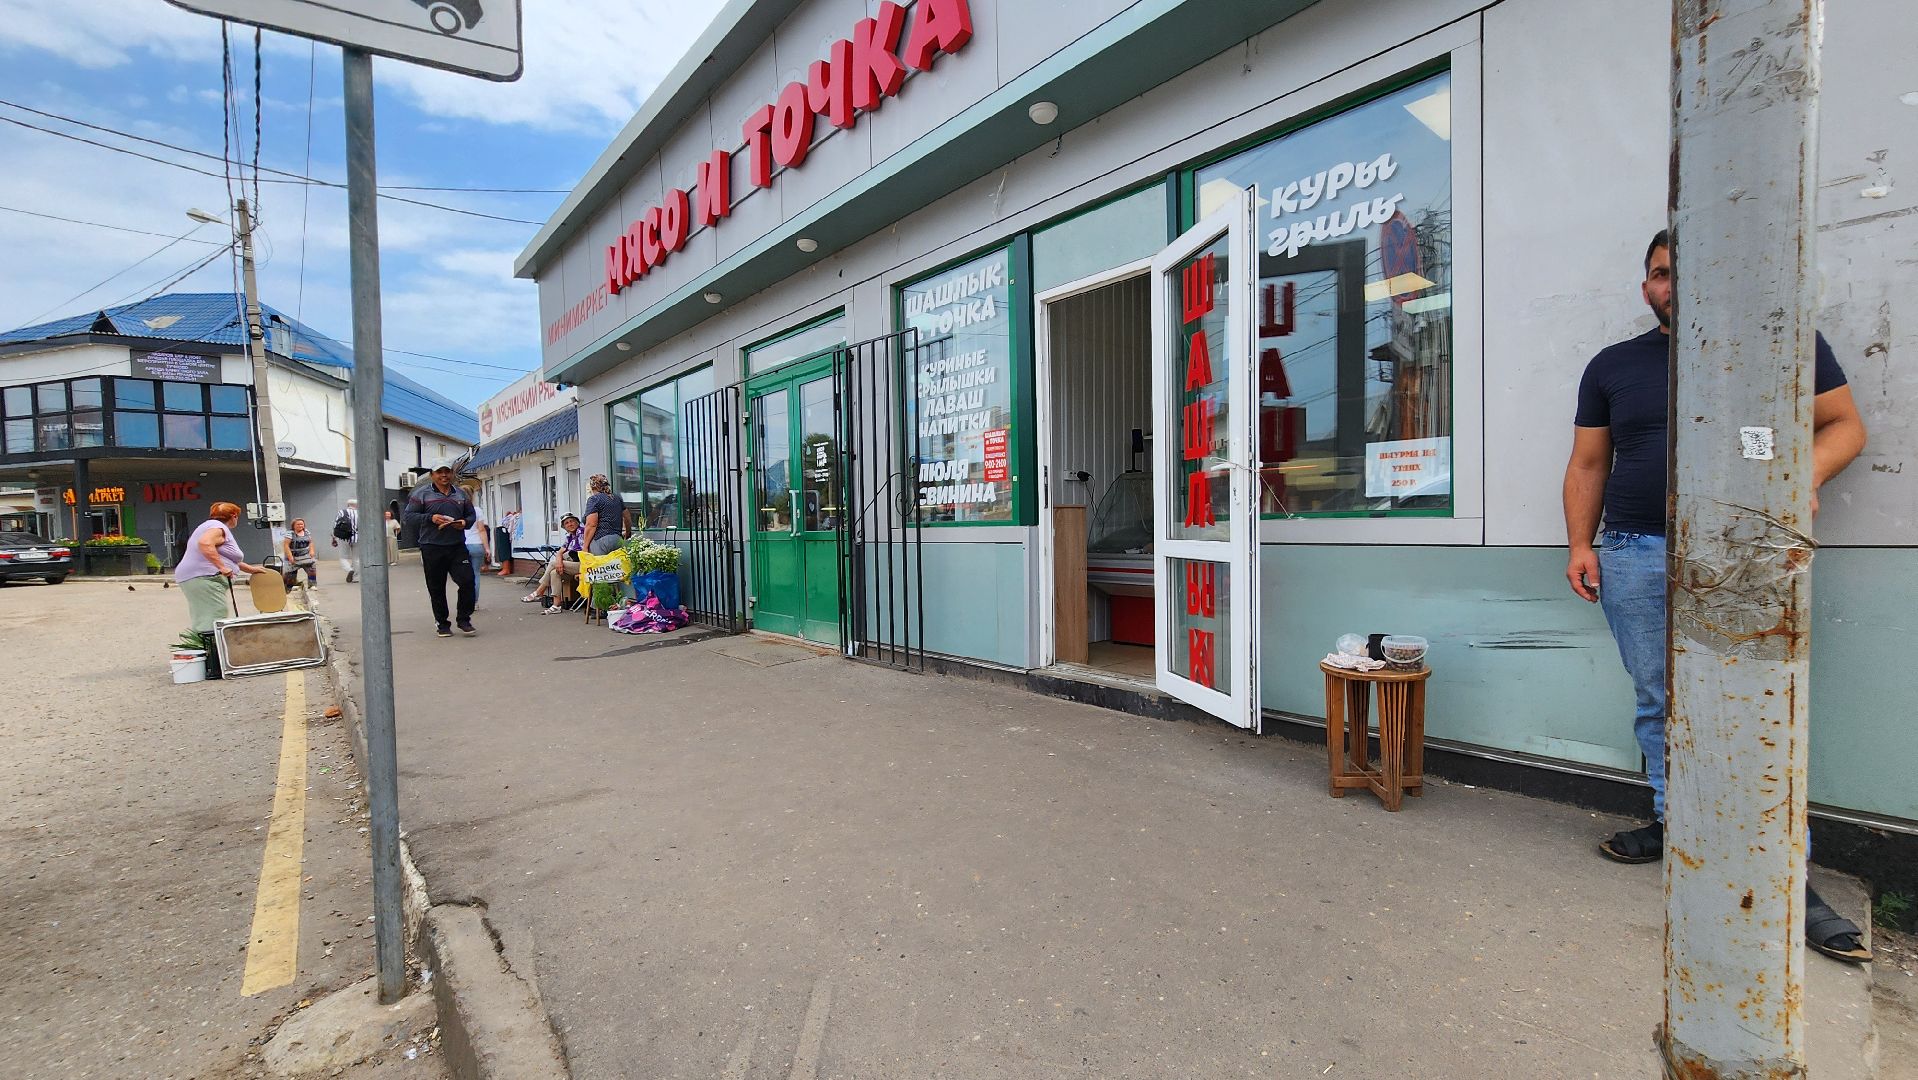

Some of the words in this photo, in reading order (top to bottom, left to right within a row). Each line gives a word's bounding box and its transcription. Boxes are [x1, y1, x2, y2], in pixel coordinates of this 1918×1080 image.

[605, 188, 689, 294] МЯСО
[697, 150, 730, 227] И
[742, 0, 973, 188] ТОЧКА
[1271, 153, 1397, 219] КУРЫ
[1268, 193, 1404, 259] гриль
[906, 262, 1002, 318] ШАШЛЫК
[547, 284, 609, 346] МИНИМАРКЕТ
[928, 295, 996, 337] ТОЧКА
[921, 349, 986, 378] КУРИНЫЕ
[924, 389, 983, 417] ЛАВАШ
[919, 411, 991, 438] НАПИТКИ
[919, 459, 969, 482] ЛЮЛЯ
[1392, 479, 1408, 487] 250
[154, 480, 201, 503] МТС
[587, 563, 622, 575] Яндекс
